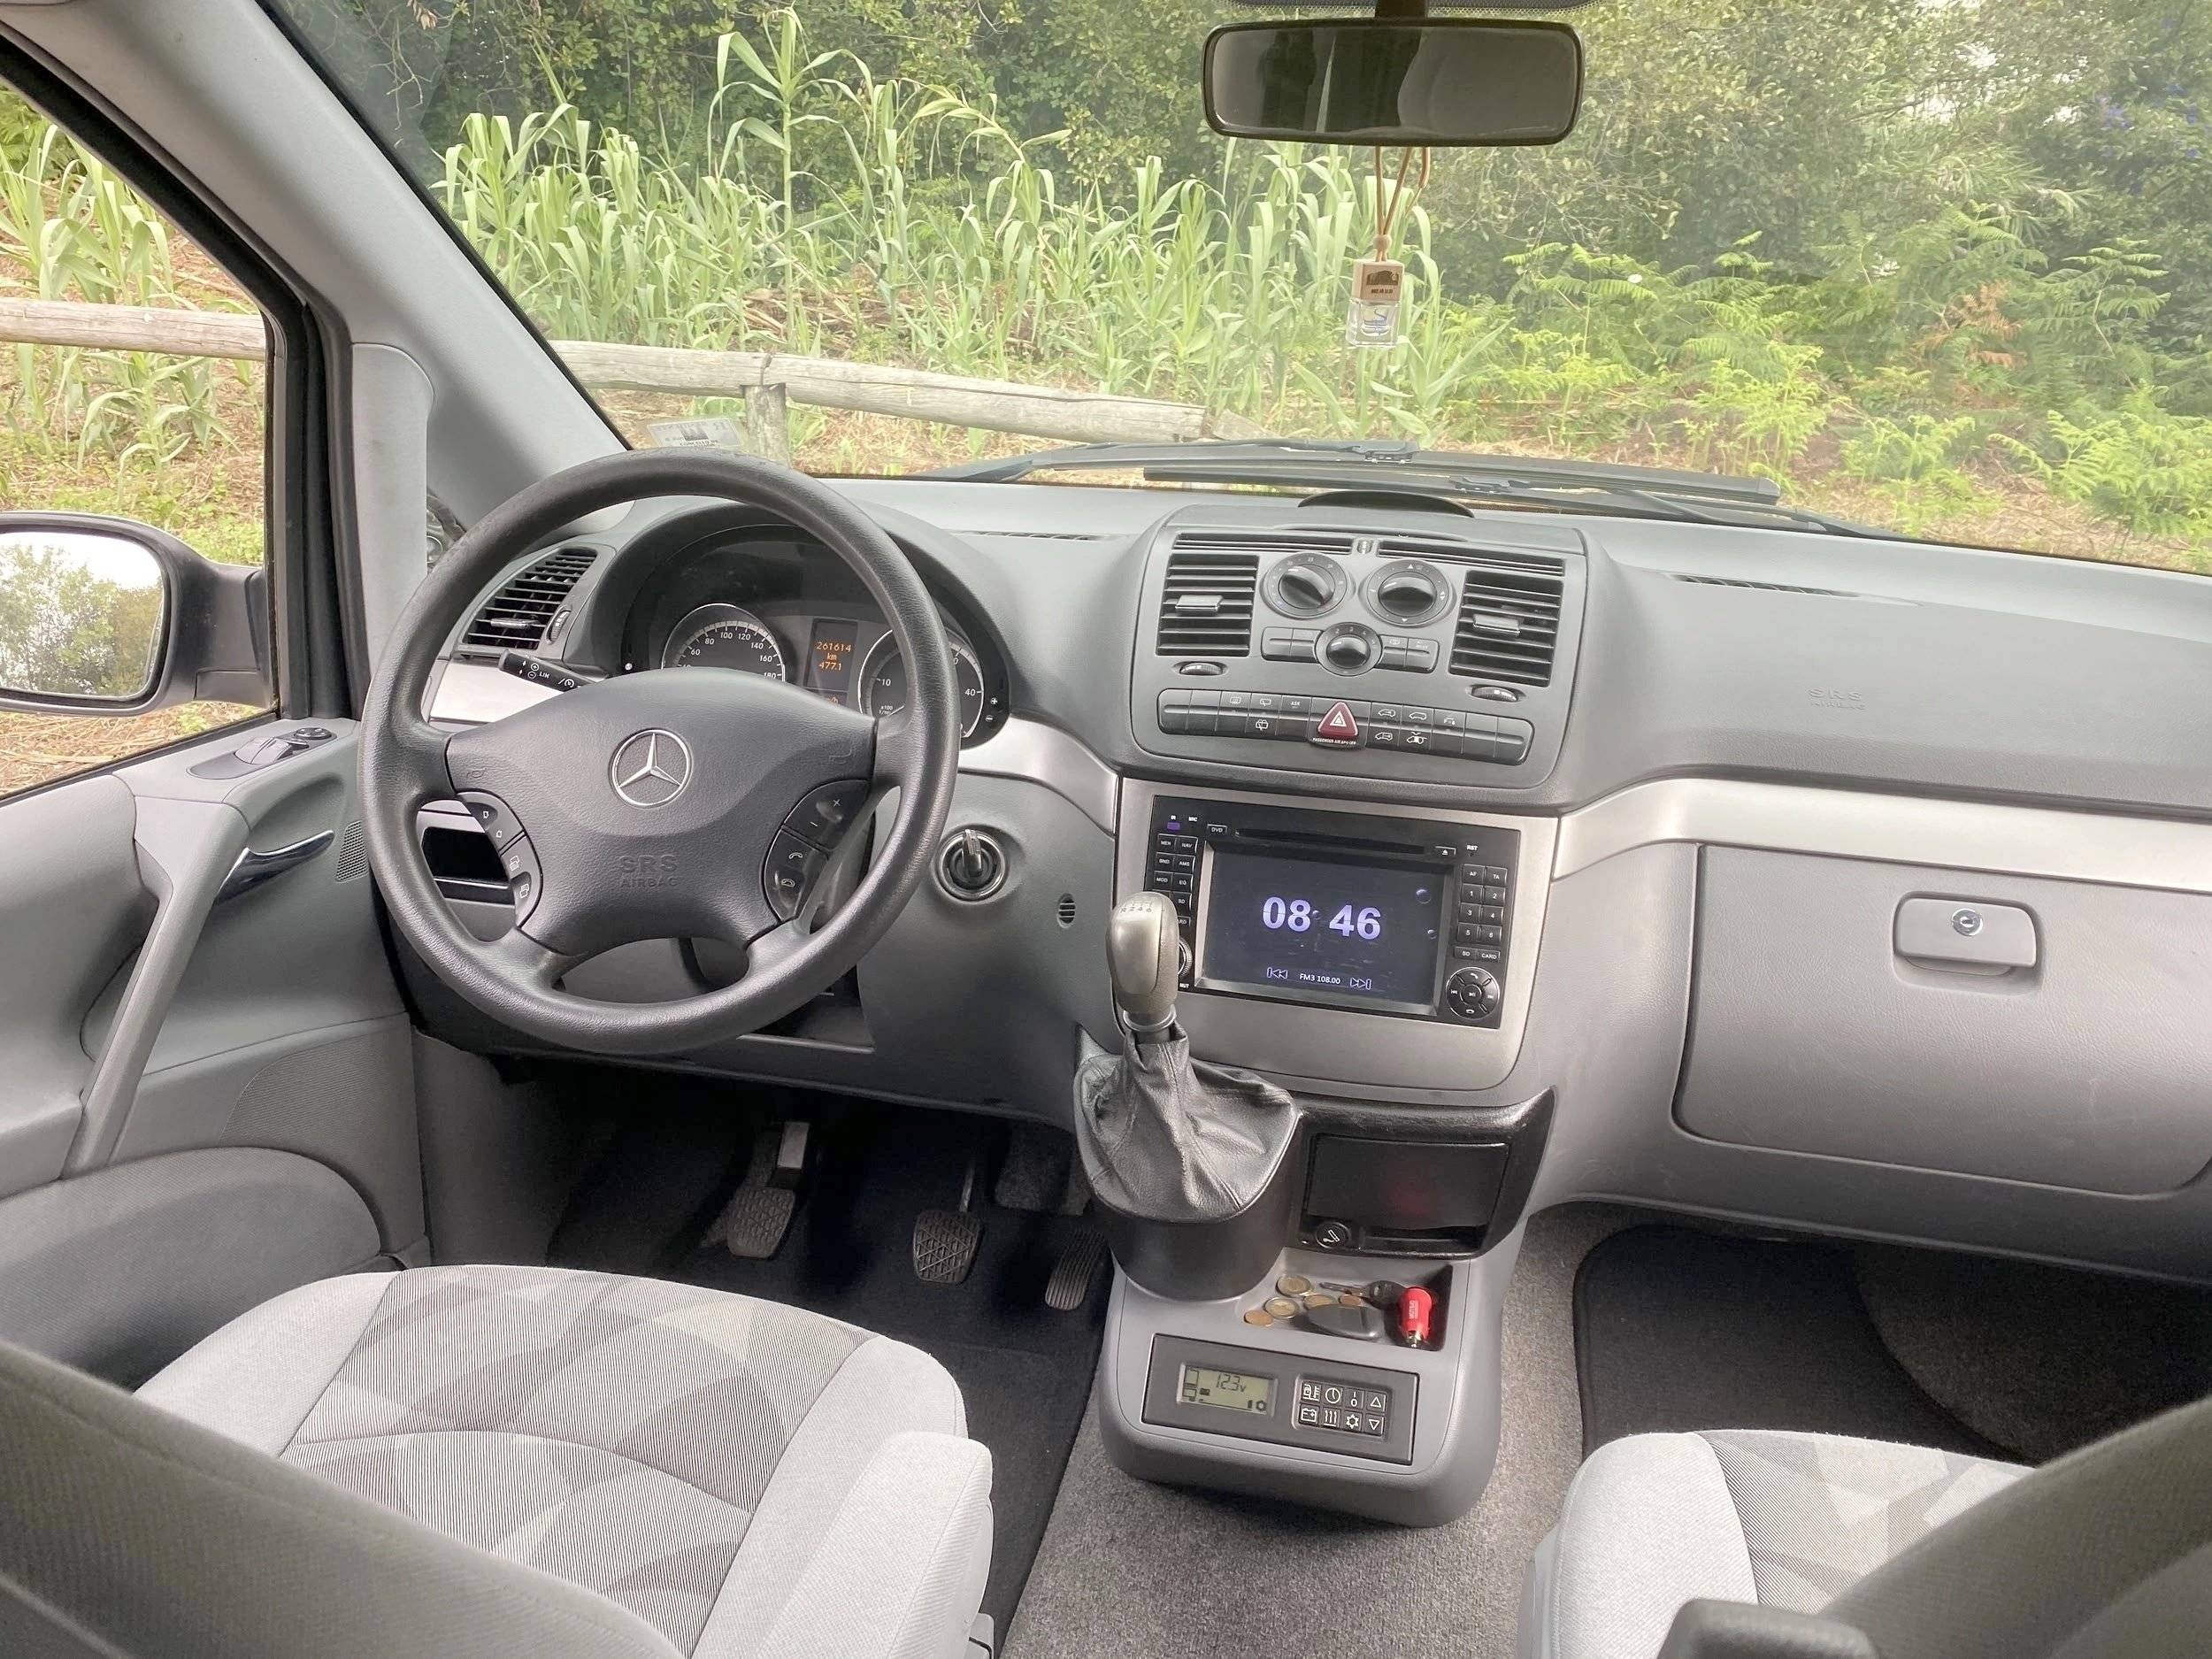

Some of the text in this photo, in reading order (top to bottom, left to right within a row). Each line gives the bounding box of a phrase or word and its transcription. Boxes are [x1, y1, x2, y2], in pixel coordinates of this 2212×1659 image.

[817, 641, 851, 652] 261614
[818, 662, 841, 671] 477.1
[618, 855, 678, 872] SRS
[1329, 904, 1381, 940] 46
[1317, 975, 1341, 985] 108.00
